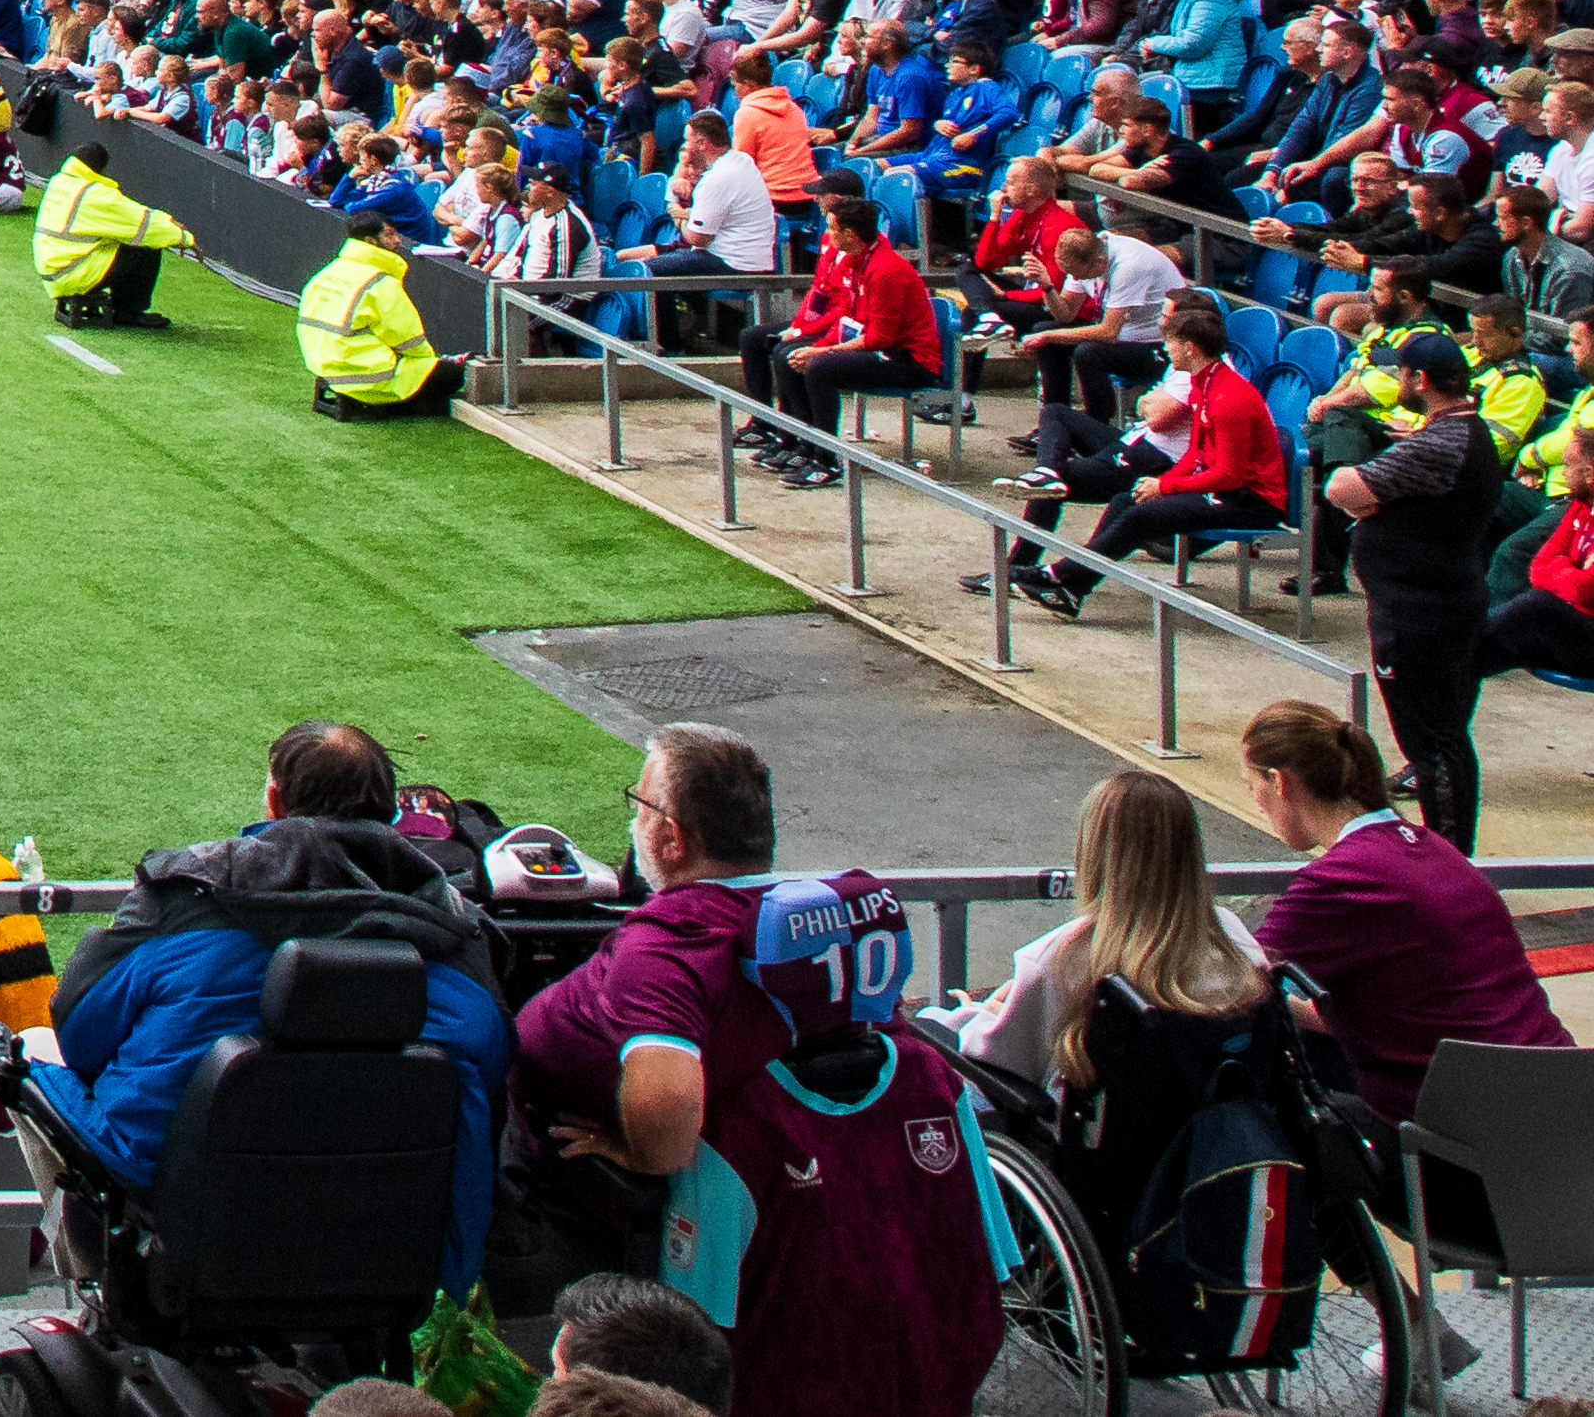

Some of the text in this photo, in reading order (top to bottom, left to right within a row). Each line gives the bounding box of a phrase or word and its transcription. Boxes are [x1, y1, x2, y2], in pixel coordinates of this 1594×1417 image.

[38, 885, 54, 913] 8
[788, 887, 900, 941] PHILLIPS
[812, 929, 898, 1004] 10
